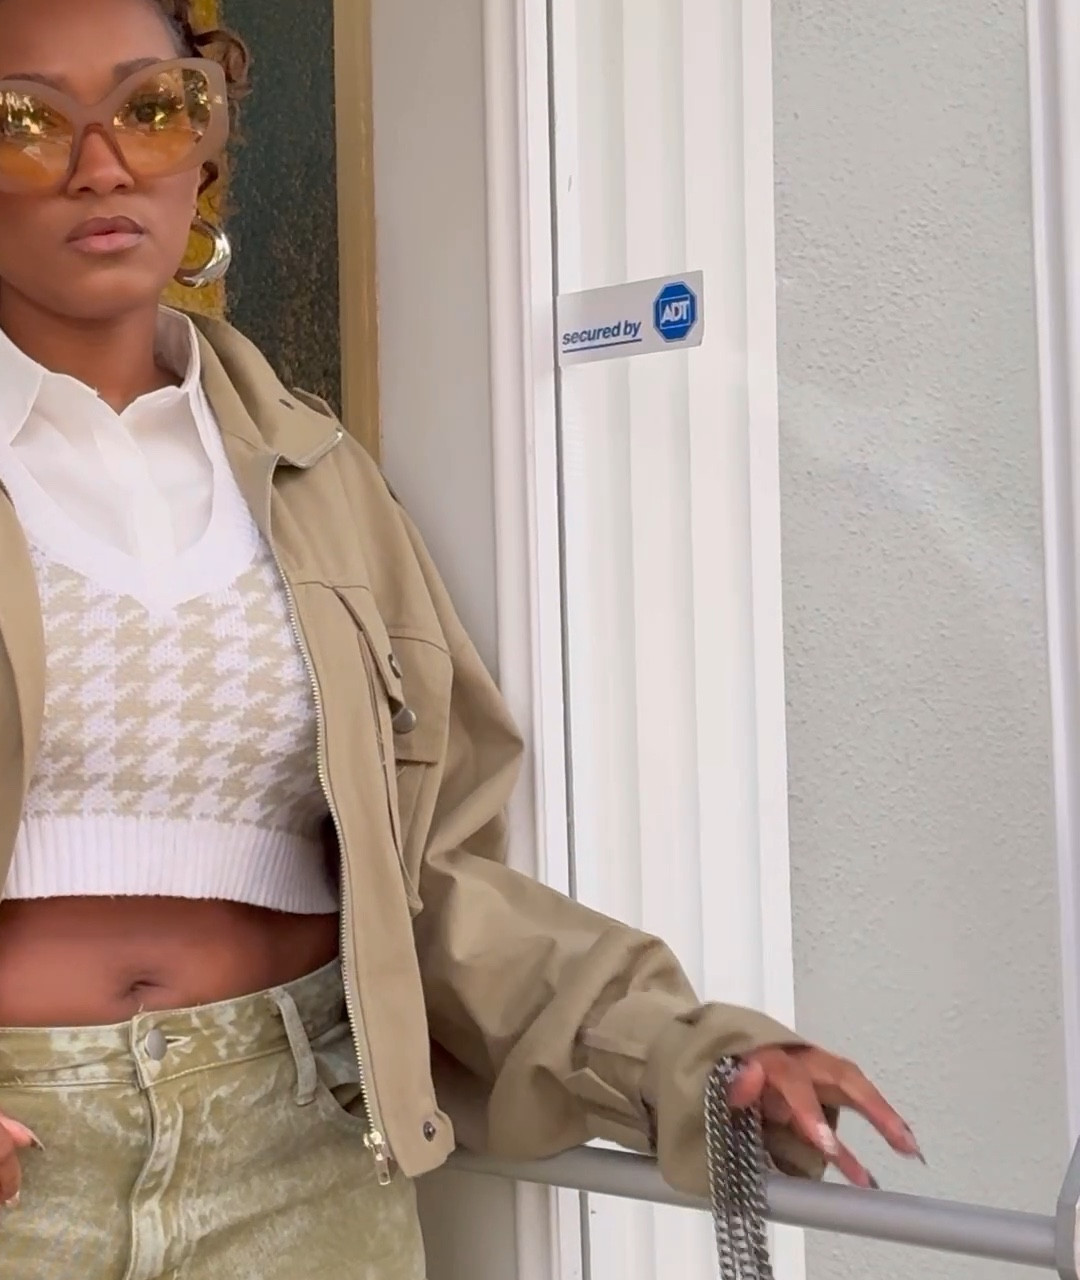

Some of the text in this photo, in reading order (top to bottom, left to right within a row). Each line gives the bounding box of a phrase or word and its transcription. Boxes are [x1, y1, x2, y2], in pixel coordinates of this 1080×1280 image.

[562, 300, 690, 345] secured by ADT
